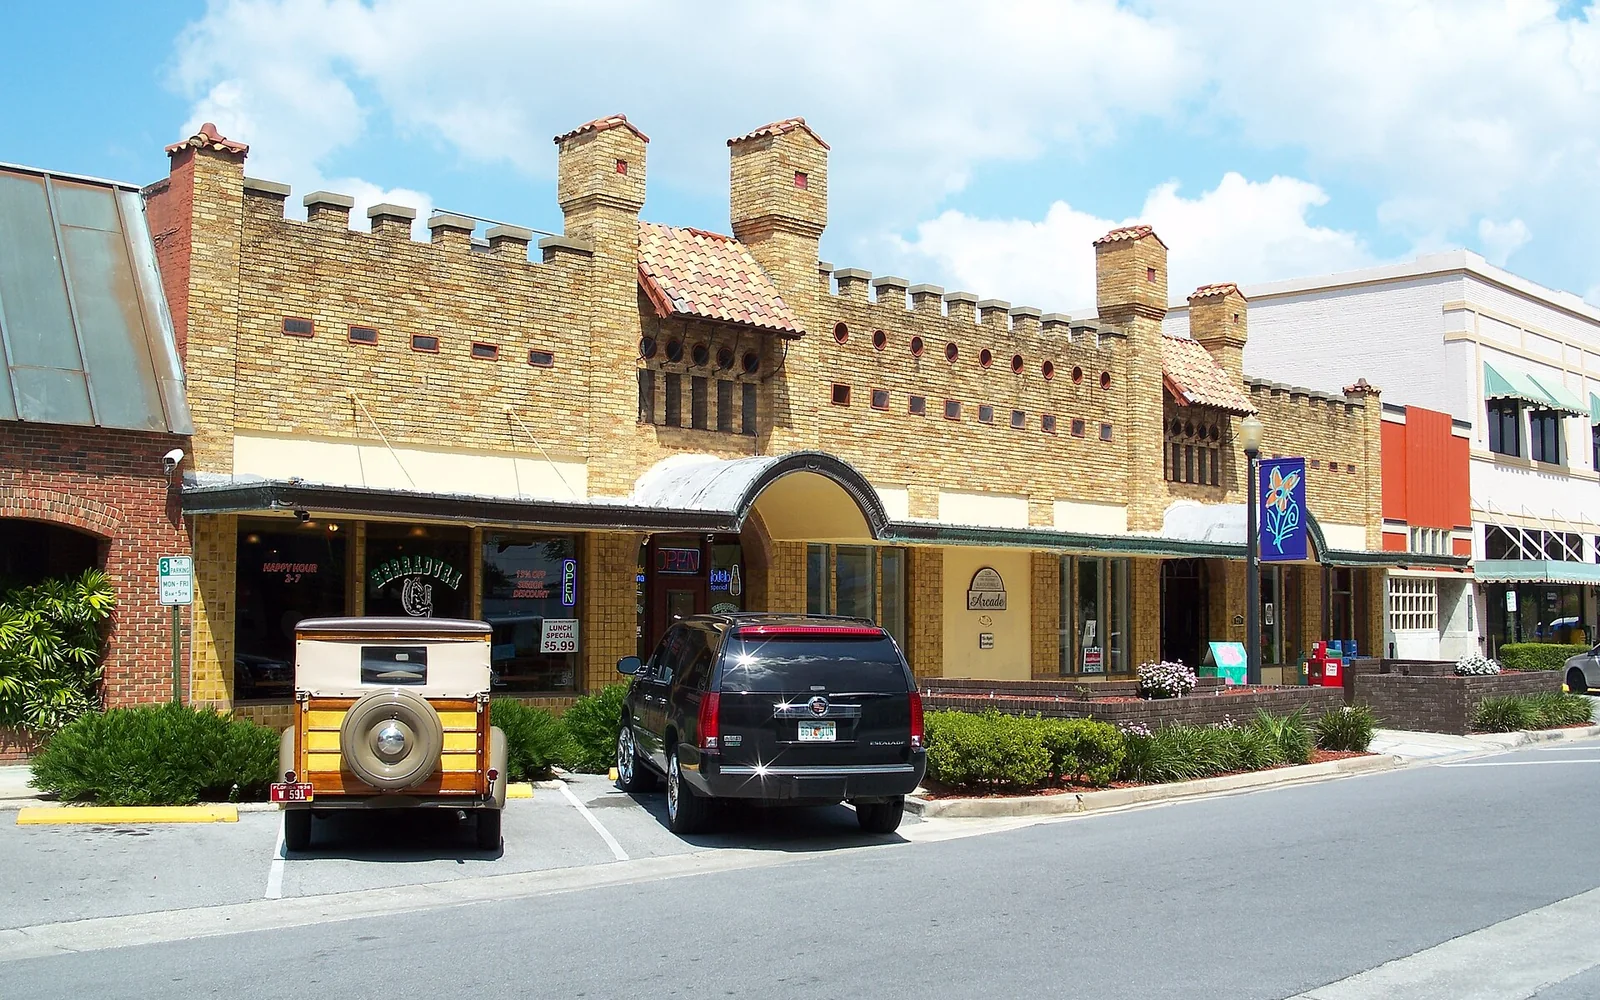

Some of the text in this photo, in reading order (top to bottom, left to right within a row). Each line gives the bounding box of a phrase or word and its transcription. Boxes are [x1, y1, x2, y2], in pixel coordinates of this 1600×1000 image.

[161, 561, 169, 573] 3
[263, 562, 318, 573] HAPPY HOUR
[370, 555, 463, 591] HERRADURA
[532, 570, 546, 579] OFF
[517, 581, 544, 589] SENIOR
[565, 562, 574, 603] OPEN
[513, 589, 550, 599] DISCOUNT
[970, 593, 1005, 608] Arcade
[544, 641, 575, 651] $5.99
[289, 789, 306, 799] 591
